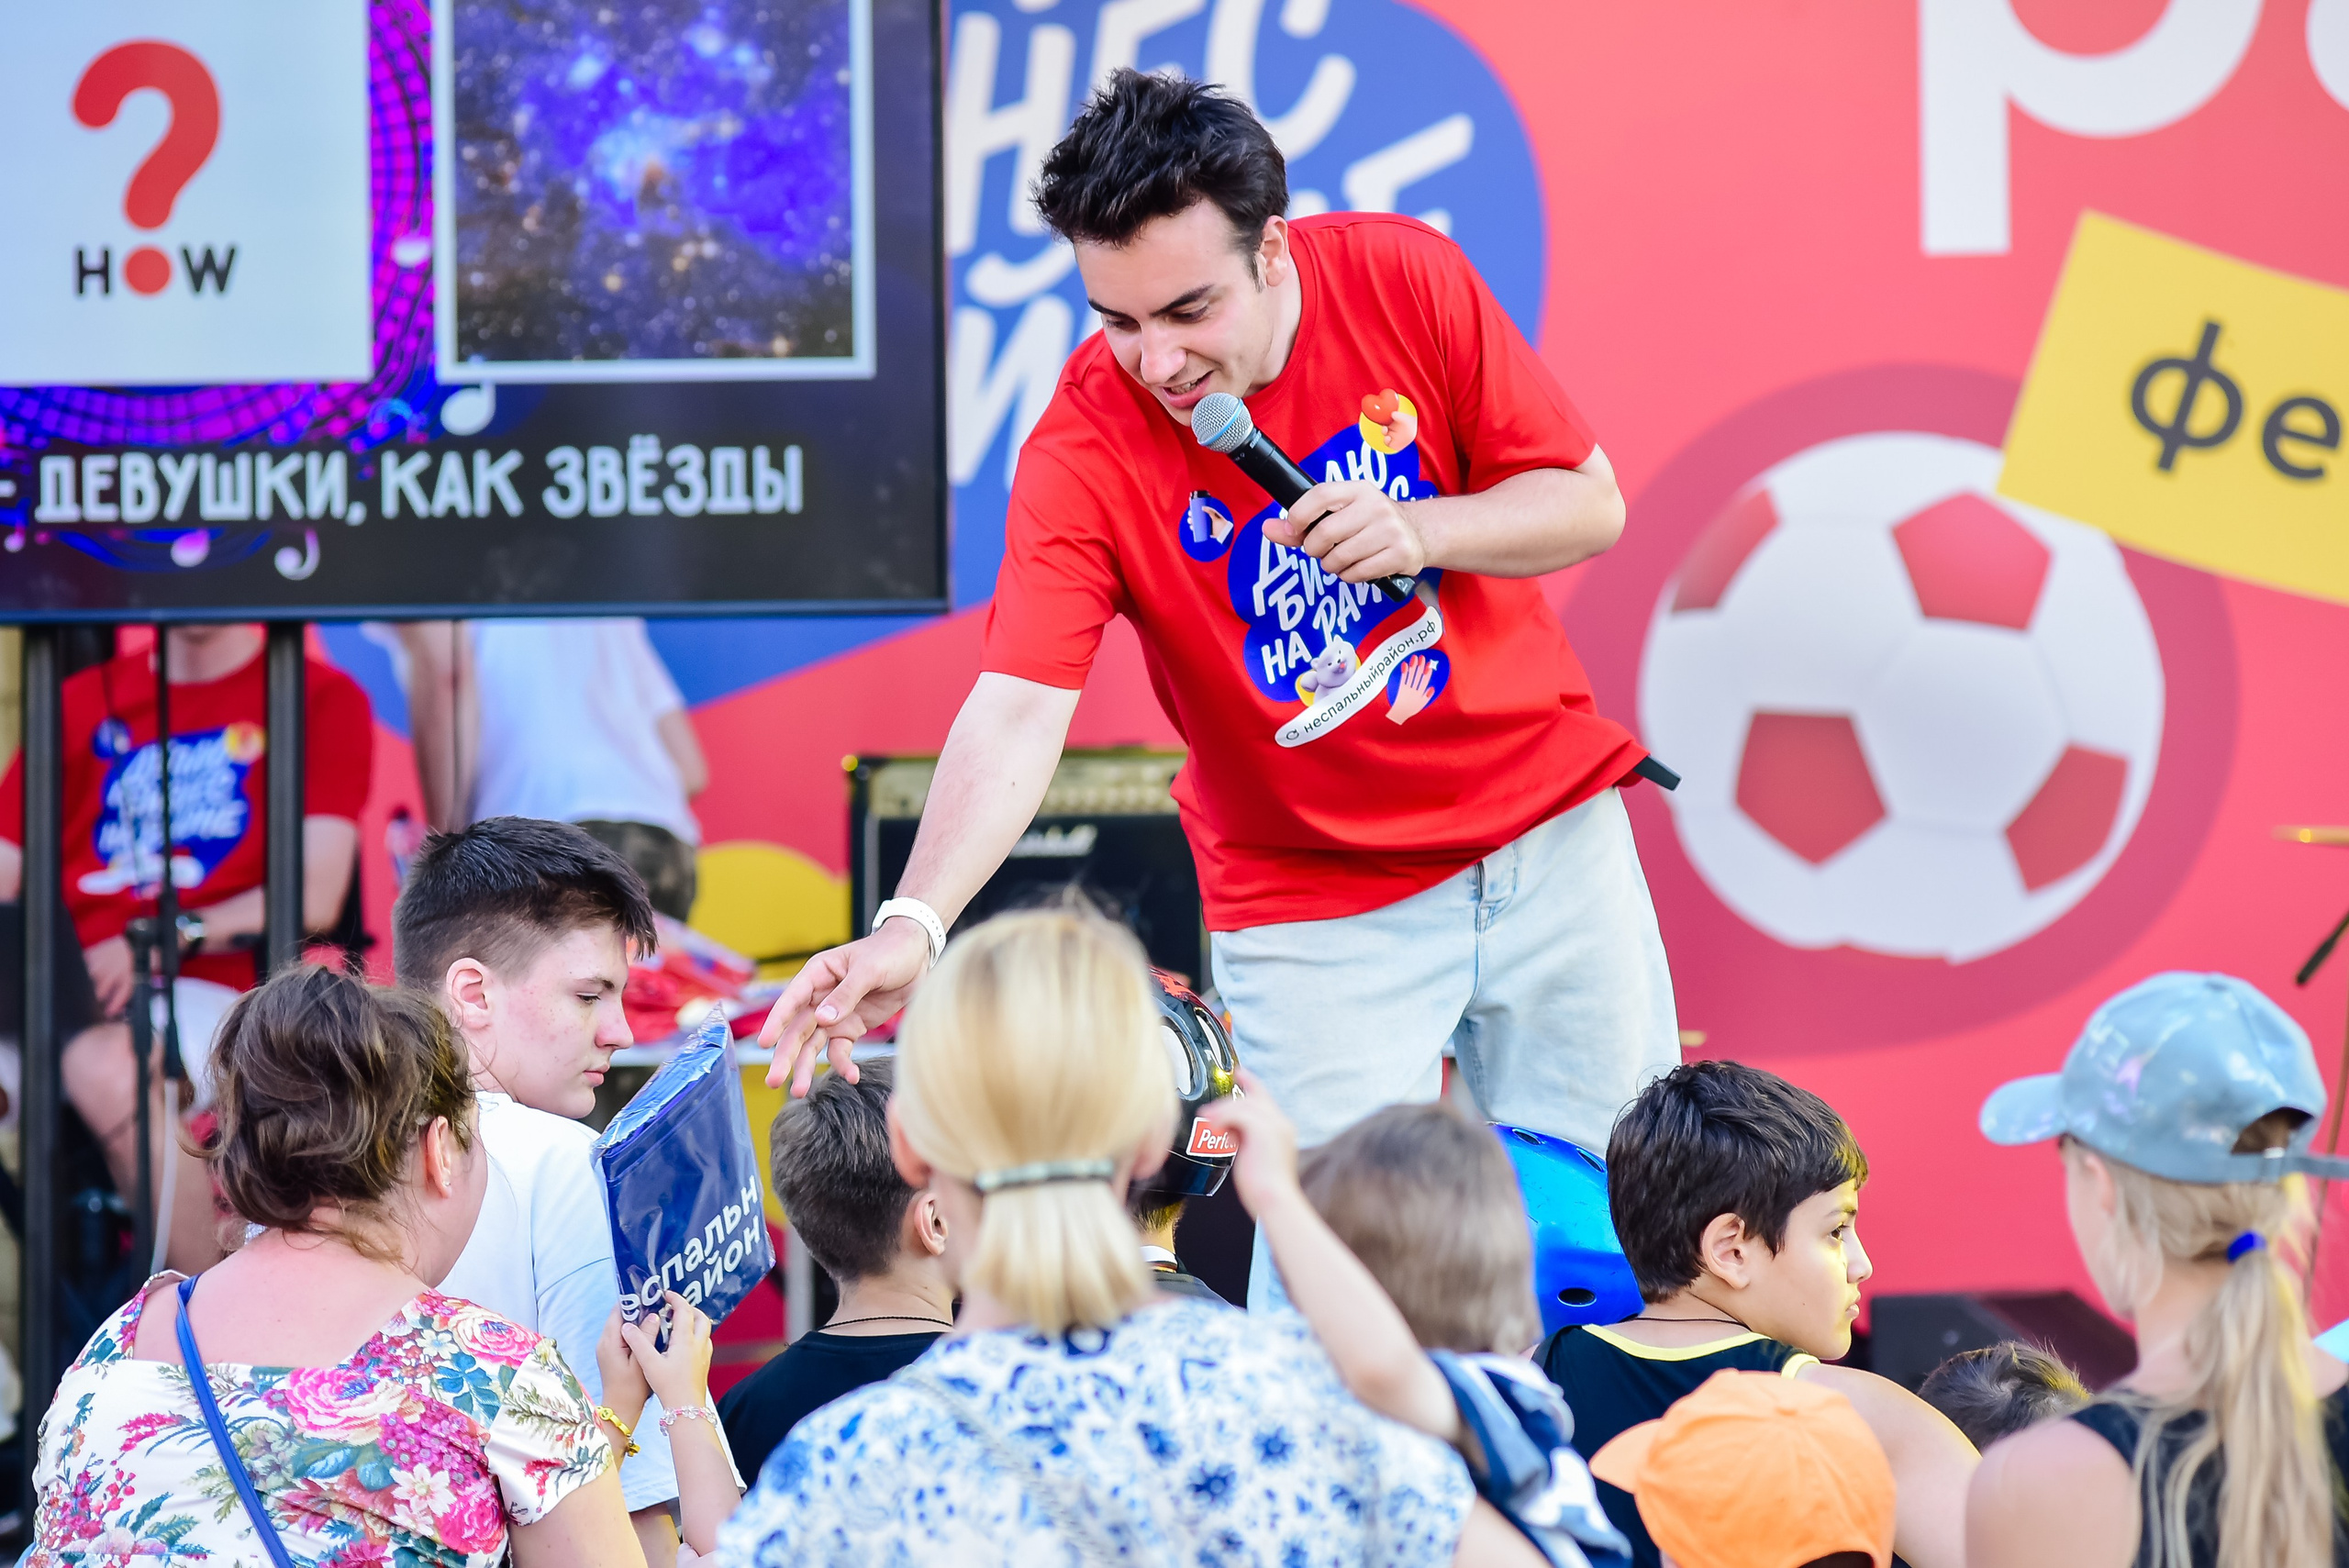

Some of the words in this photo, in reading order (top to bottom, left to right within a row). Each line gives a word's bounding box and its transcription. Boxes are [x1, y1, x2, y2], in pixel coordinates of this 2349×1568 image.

[2128, 317, 2343, 483] фе
[34, 450, 366, 526] ДЕВУШКИ,
[381, 450, 525, 519] КАК
[541, 433, 805, 519] ЗВЁЗДЫ
[1261, 631, 1313, 684] НА
[1303, 620, 1437, 734] неспальныйрайон.рф
